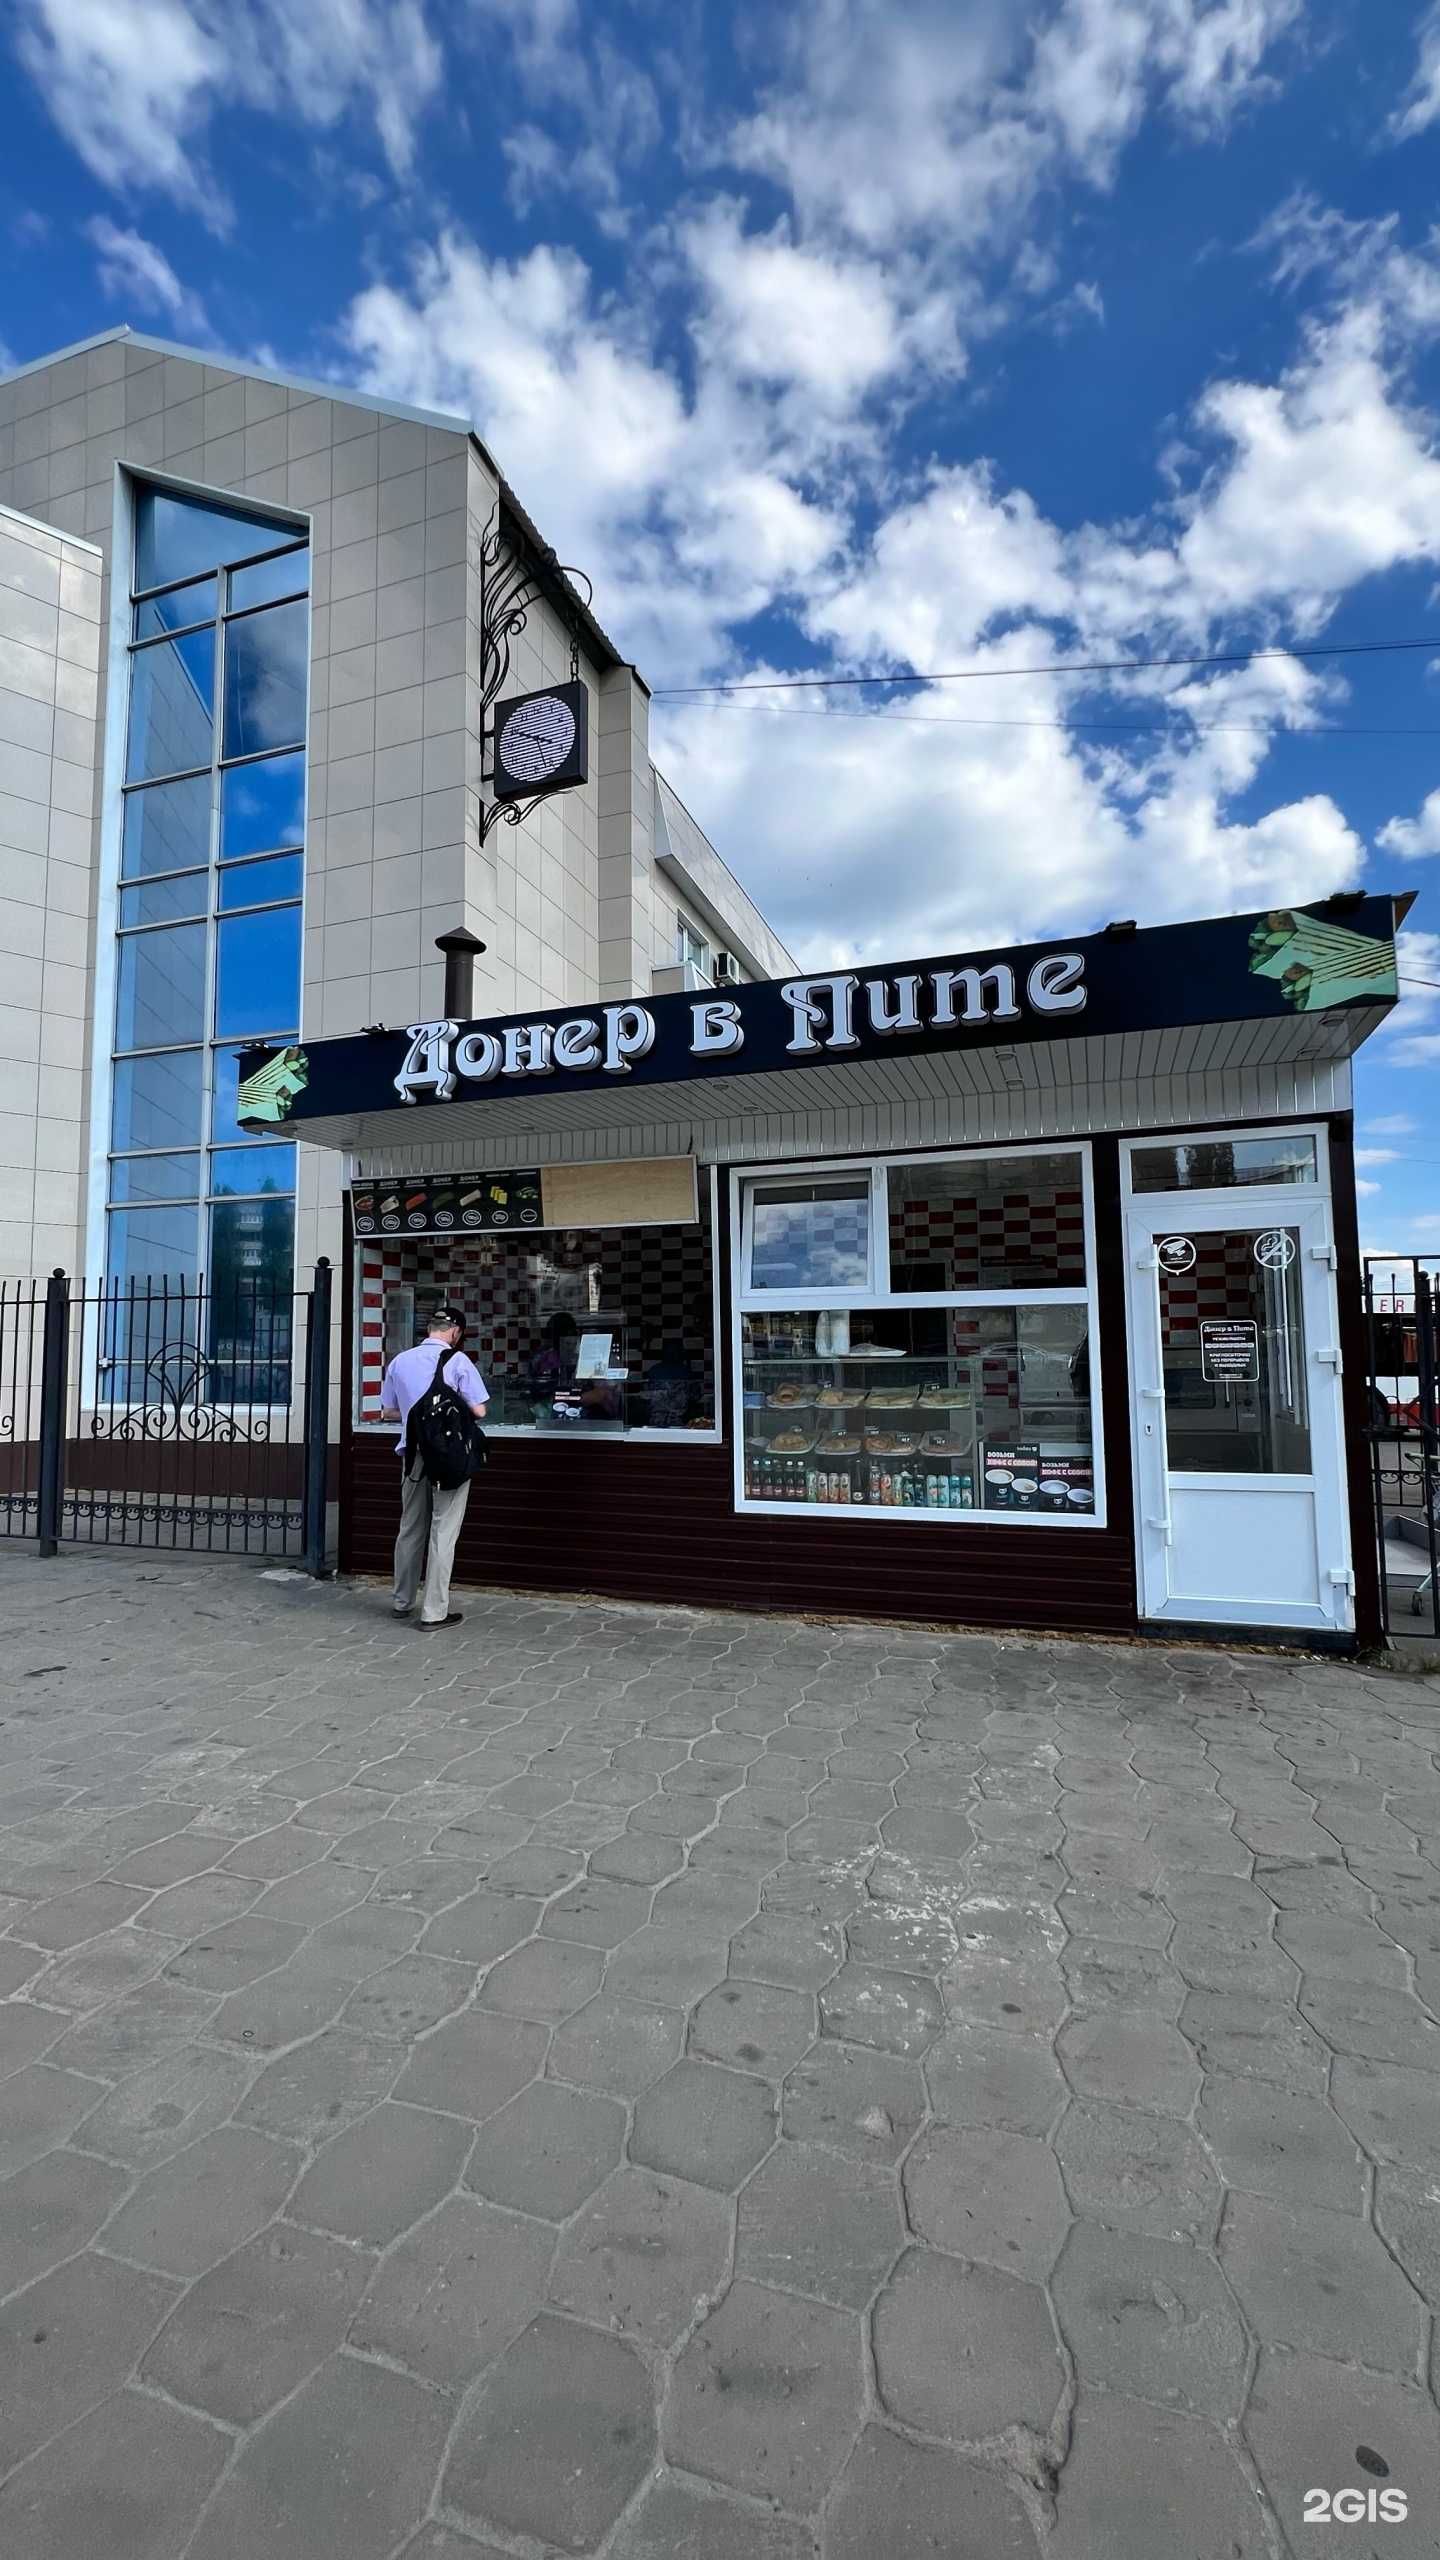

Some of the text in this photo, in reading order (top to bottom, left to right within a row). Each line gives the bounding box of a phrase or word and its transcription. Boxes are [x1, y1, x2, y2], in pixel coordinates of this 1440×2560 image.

[394, 951, 1089, 1104] Донер в Пите
